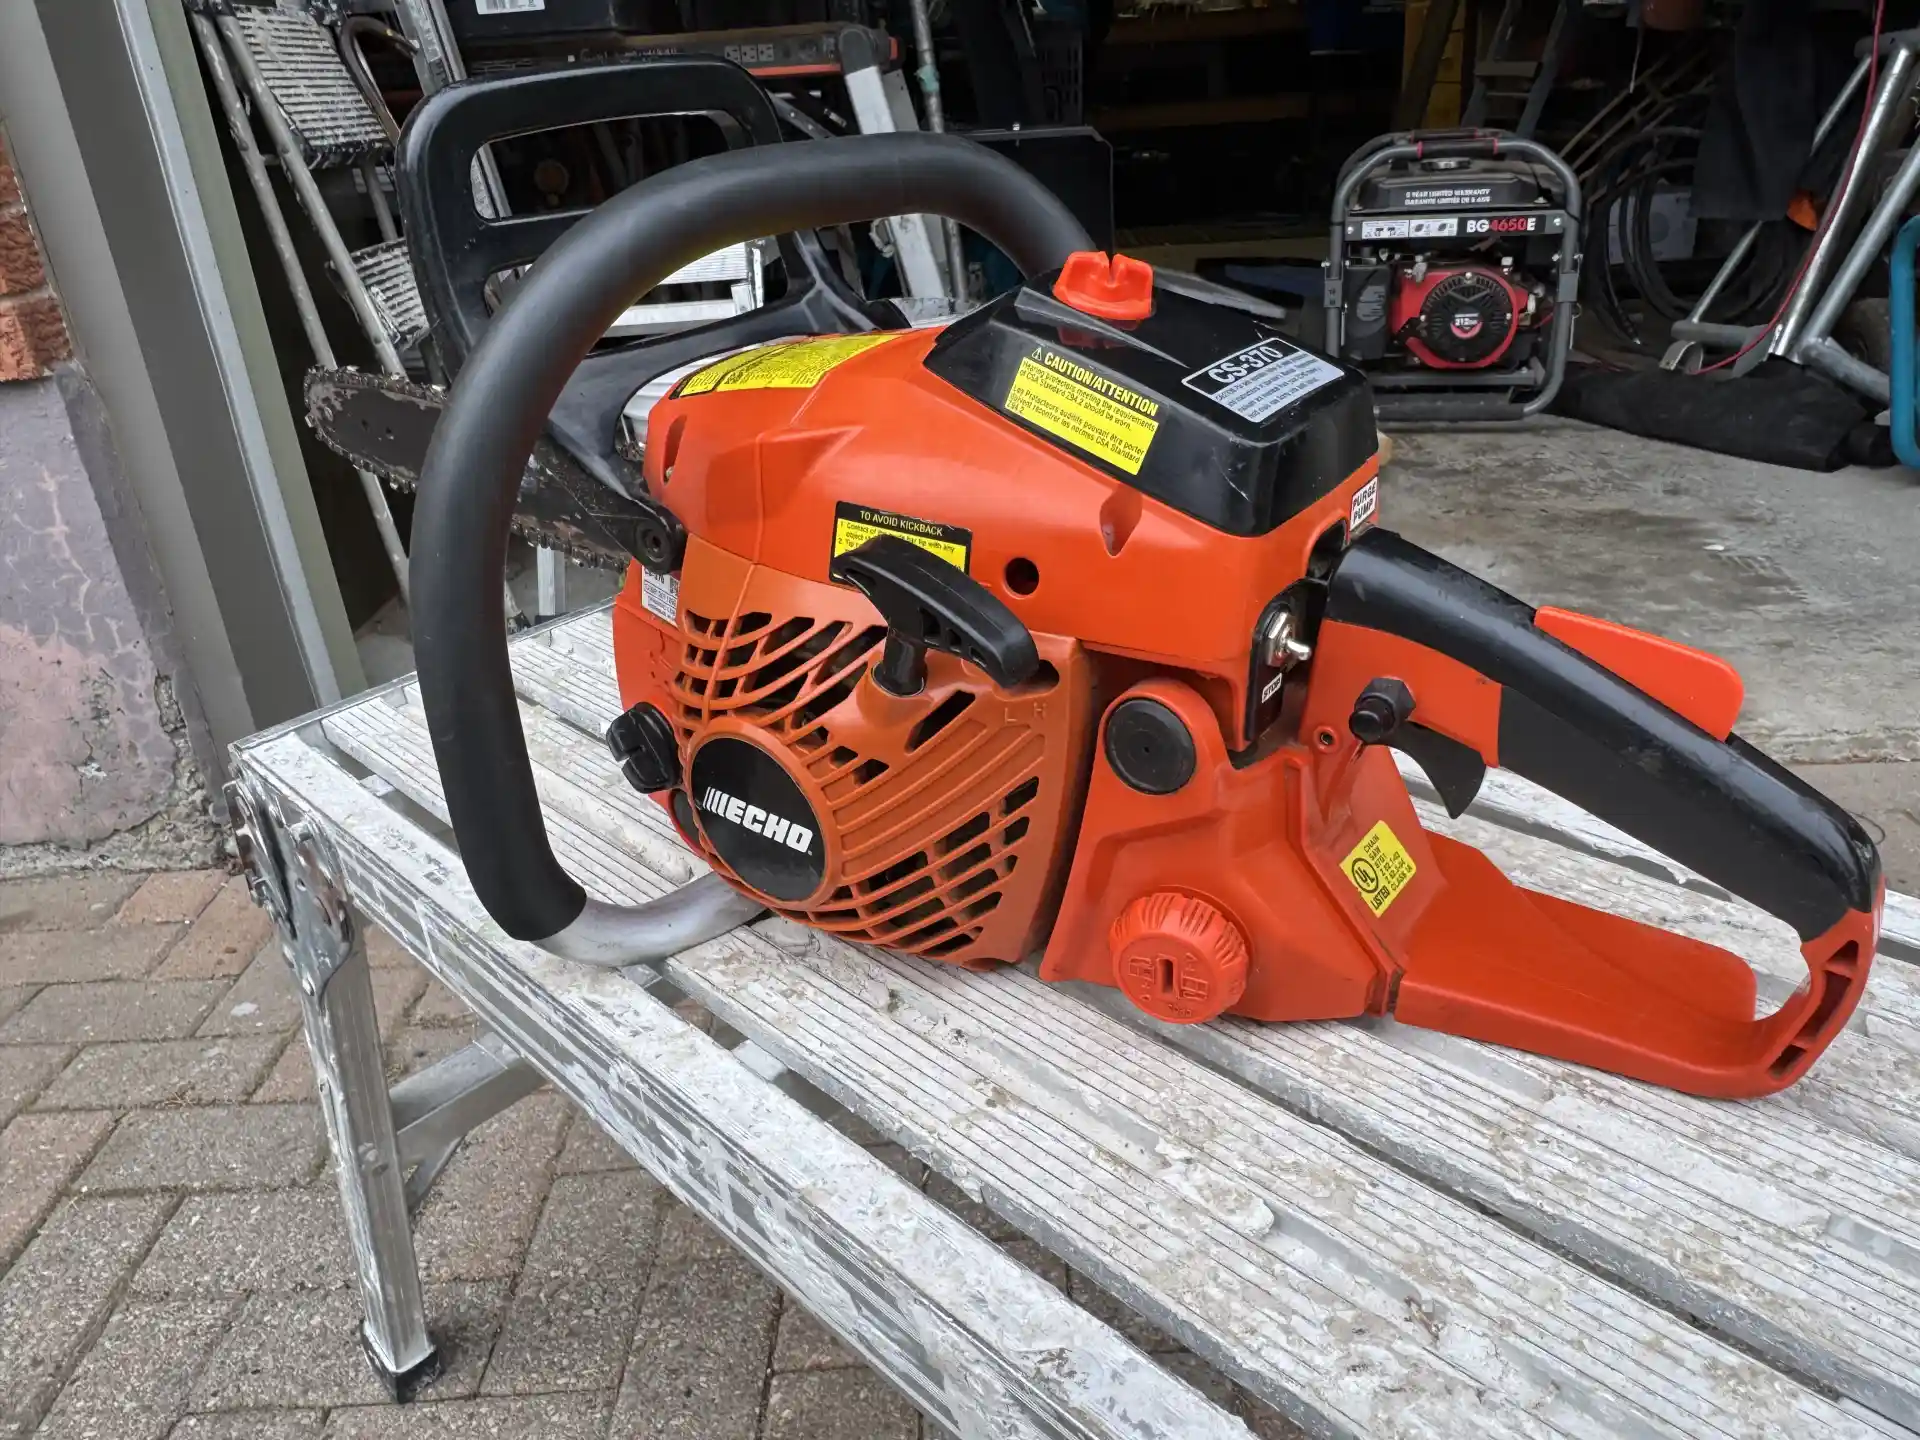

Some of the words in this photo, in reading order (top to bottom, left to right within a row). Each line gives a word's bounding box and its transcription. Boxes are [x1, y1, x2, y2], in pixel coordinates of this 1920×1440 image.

[1467, 218, 1536, 233] BG4650E
[1208, 346, 1283, 383] CS-370
[1044, 352, 1158, 416] CAUTION/ATTENTION
[1039, 378, 1066, 397] Standard
[1083, 400, 1105, 417] should
[1104, 410, 1114, 421] be
[1044, 371, 1076, 393] protectors
[1075, 387, 1101, 405] meeting
[1101, 399, 1113, 410] the
[1112, 405, 1155, 432] requirements
[1095, 435, 1109, 448] CSA
[1110, 443, 1140, 464] Standard
[1123, 440, 1144, 457] porter
[1353, 481, 1376, 510] PURGE
[860, 510, 870, 520] TO
[873, 514, 898, 526] AVOID
[900, 520, 942, 536] KICKBACK
[1354, 498, 1373, 524] PUMP
[726, 796, 813, 853] ECHO
[1364, 834, 1379, 853] CHAIN
[1368, 845, 1380, 860] SAW
[1355, 866, 1376, 883] UL
[1370, 885, 1390, 910] LISTED
